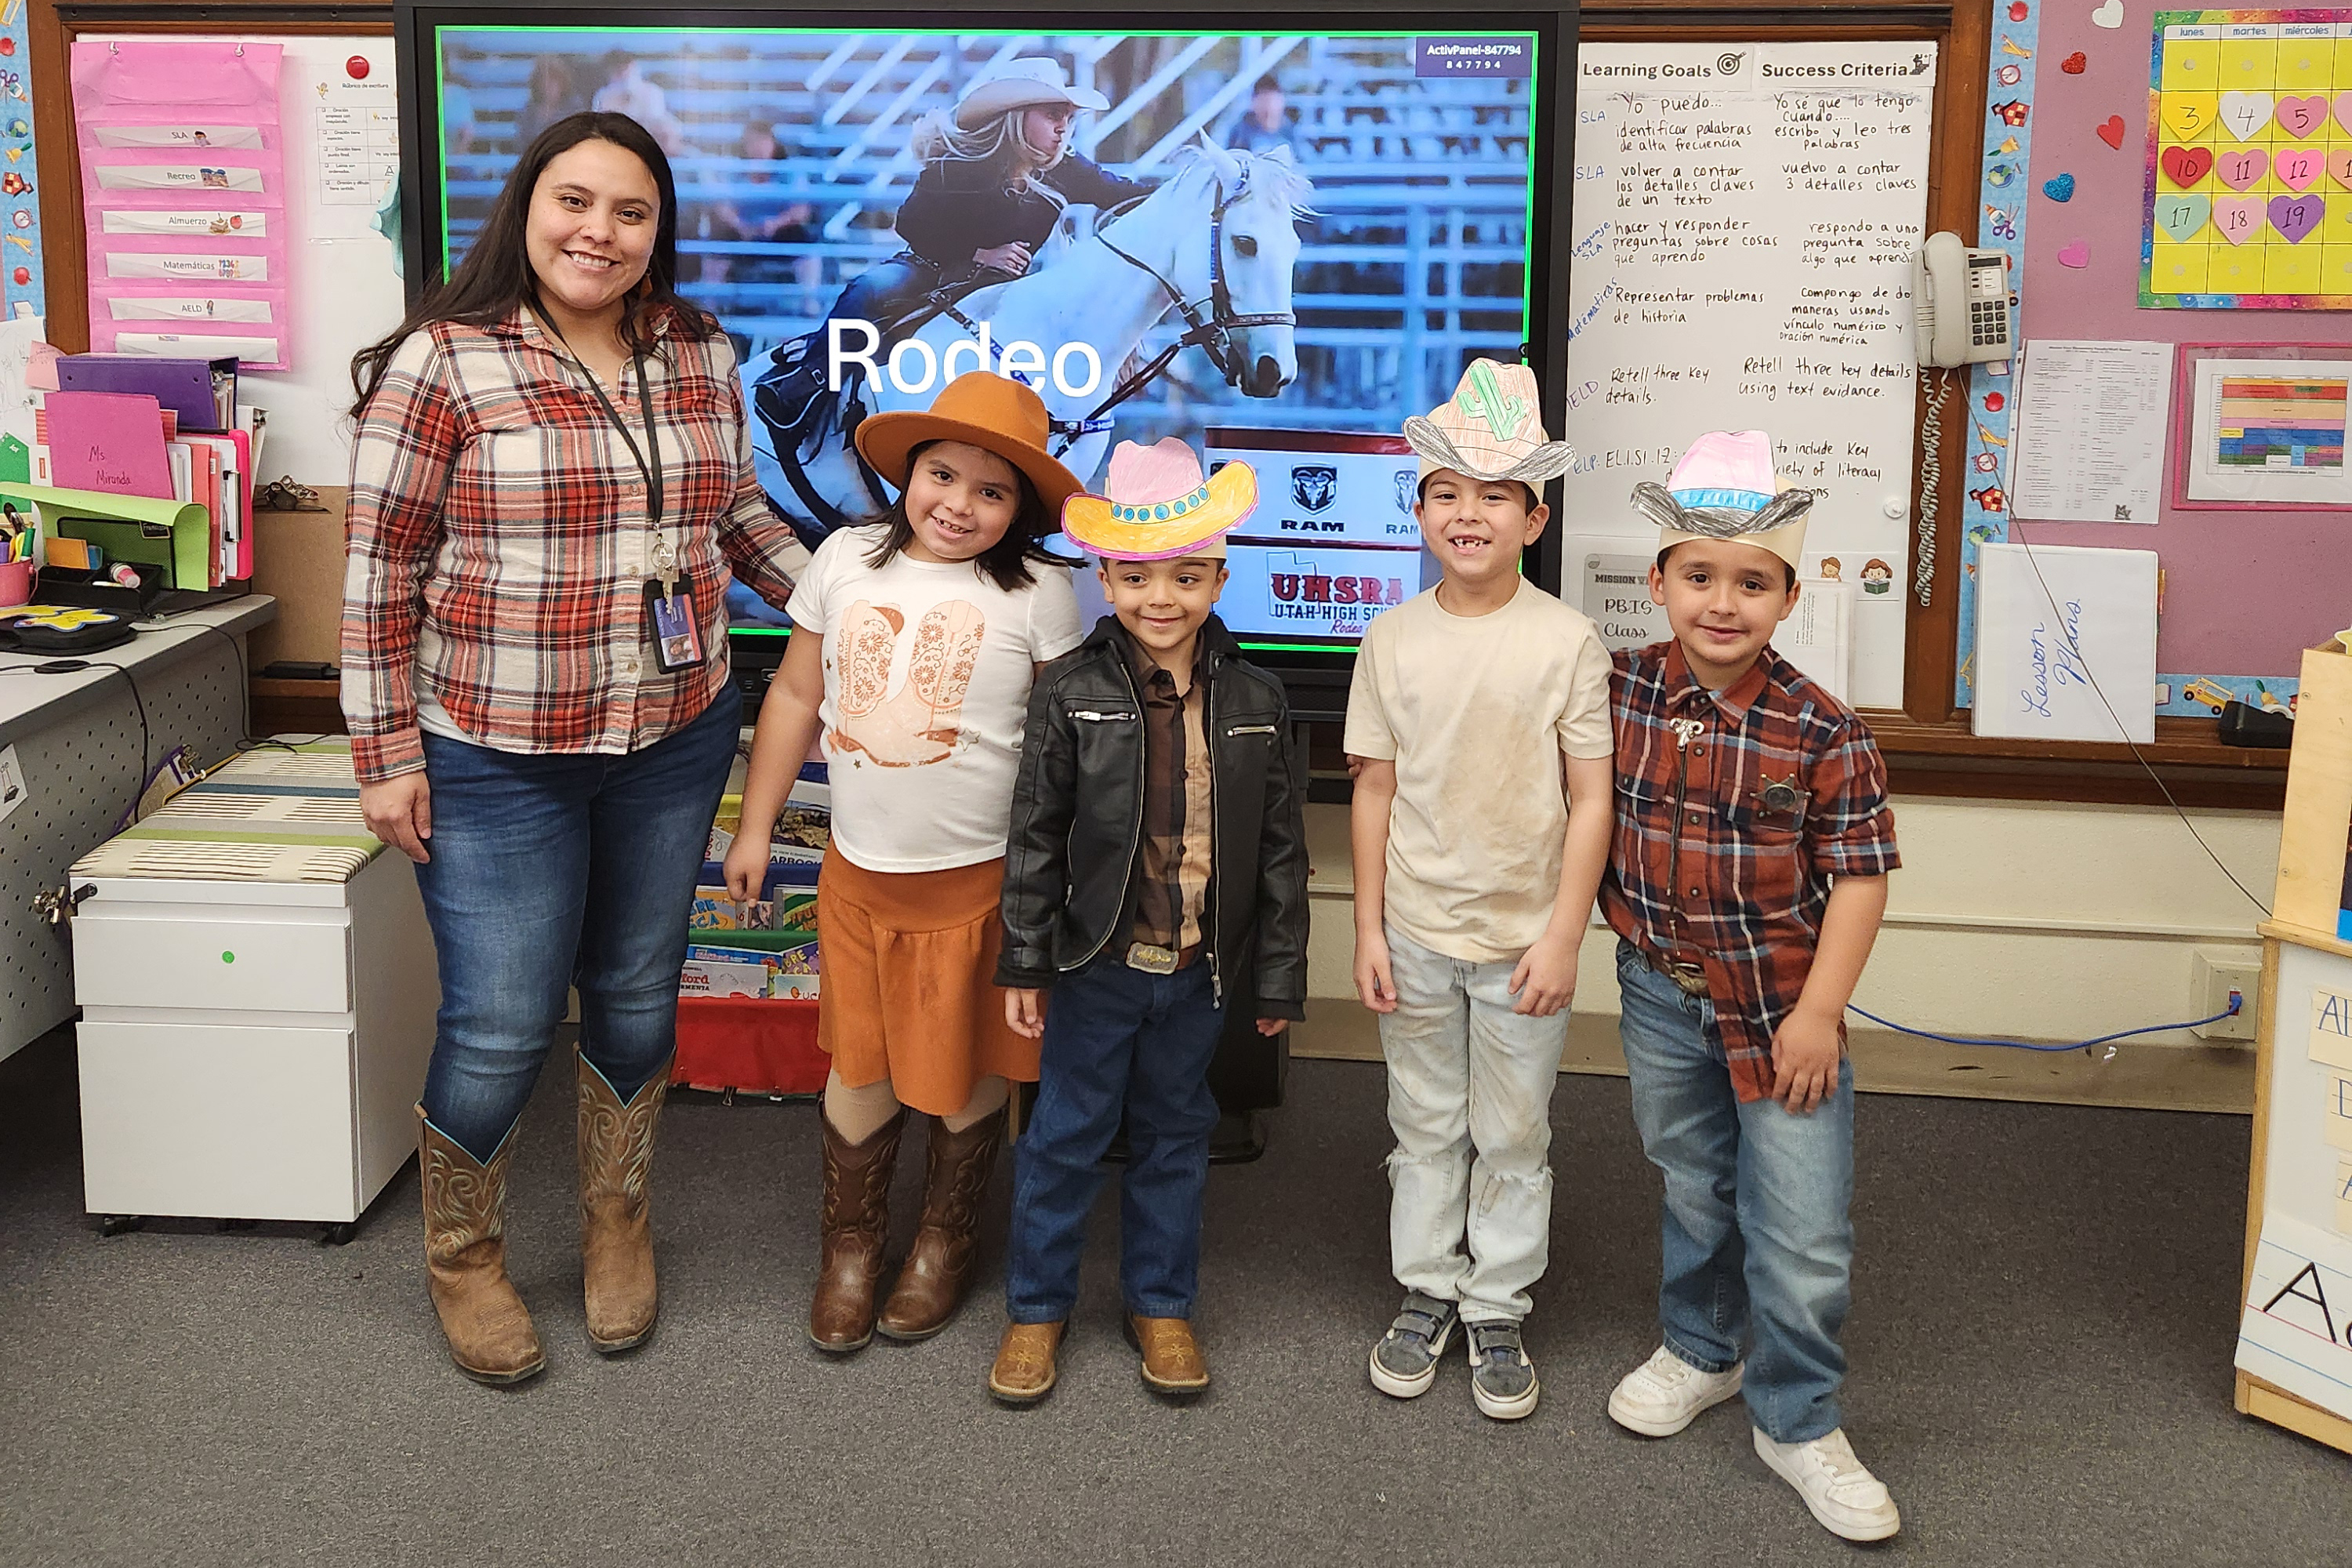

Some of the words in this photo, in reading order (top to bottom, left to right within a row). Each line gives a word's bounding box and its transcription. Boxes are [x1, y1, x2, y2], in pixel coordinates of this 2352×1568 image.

[2233, 27, 2267, 35] martes
[2285, 26, 2329, 34] miércoles
[1427, 44, 1522, 56] ActivPanel-847794
[1584, 64, 1657, 79] Learning
[1662, 64, 1711, 77] Goals
[1762, 64, 1836, 76] Success
[1842, 63, 1907, 76] Criteria
[1621, 92, 1643, 113] Yo
[1773, 93, 1788, 110] Yo
[1795, 96, 1809, 109] sé
[1818, 98, 1841, 113] que
[1854, 94, 1864, 107] lo
[1875, 93, 1914, 112] tengo
[1581, 111, 1606, 123] SLA
[2179, 106, 2200, 130] 3
[2238, 106, 2256, 132] 4
[2295, 108, 2310, 129] 5
[1615, 120, 1688, 137] identificar
[1696, 121, 1752, 139] palabras
[1774, 124, 1820, 136] escribo
[1832, 127, 1841, 139] y
[1855, 122, 1877, 136] leo
[1887, 121, 1911, 134] tres
[1620, 138, 1633, 152] de
[1639, 139, 1667, 151] alta
[1675, 136, 1742, 150] frecuencia
[166, 172, 196, 180] Recreo
[1575, 165, 1605, 180] SLA
[1621, 162, 1663, 177] volver
[1672, 167, 1682, 177] a
[1693, 163, 1744, 177] contar
[1781, 161, 1827, 174] vuelvo
[1837, 165, 1847, 175] a
[1857, 160, 1901, 176] contar
[2177, 159, 2198, 179] 10
[2234, 159, 2251, 181] 11
[2289, 160, 2309, 180] 12
[1617, 180, 1633, 192] los
[1644, 179, 1698, 191] detalles
[1710, 179, 1755, 191] claves
[1786, 176, 1795, 190] 3
[1805, 177, 1864, 191] detalles
[1875, 177, 1918, 191] claves
[1617, 195, 1632, 207] de
[1642, 195, 1659, 206] un
[1673, 195, 1713, 206] texto
[168, 216, 208, 225] Almuerzo
[2169, 207, 2192, 229] 17
[2228, 210, 2248, 230] 18
[2282, 205, 2306, 229] 19
[1614, 220, 1650, 235] hacer
[1659, 220, 1668, 238] y
[1675, 216, 1751, 234] responder
[1809, 219, 1874, 236] respondo
[1881, 223, 1889, 232] a
[1896, 224, 1919, 234] una
[1571, 220, 1611, 258] Lenguaje
[1612, 237, 1683, 252] preguntas
[1695, 235, 1730, 248] sobre
[1742, 235, 1779, 247] cosas
[1802, 236, 1864, 252] pregunta
[1581, 243, 1603, 261] SLA
[1614, 253, 1635, 268] que
[1651, 248, 1706, 267] aprendo
[163, 261, 215, 270] Matemáticas
[1802, 253, 1826, 269] algo
[1834, 254, 1857, 268] que
[1615, 286, 1696, 305] Representar
[1705, 286, 1764, 307] problemas
[1872, 285, 1889, 298] de
[1895, 285, 1913, 299] do
[181, 304, 203, 313] AELD
[1613, 308, 1630, 324] de
[1641, 309, 1687, 324] historia
[1791, 305, 1839, 317] maneras
[1849, 303, 1891, 315] usando
[1783, 318, 1825, 331] vínculo
[1833, 320, 1887, 332] numérico
[1895, 323, 1904, 334] y
[1820, 334, 1868, 345] numérica
[828, 318, 1102, 397] Rodeo
[1653, 364, 1680, 381] three
[1743, 356, 1783, 376] Retell
[1795, 356, 1833, 376] three
[1870, 362, 1912, 379] details
[1786, 381, 1815, 397] text
[89, 445, 106, 462] Ms
[1776, 439, 1788, 453] to
[1795, 440, 1834, 456] include
[96, 469, 132, 485] Miranda
[1813, 461, 1826, 477] of
[1280, 519, 1345, 532] RAM
[1595, 574, 1636, 584] MISSION
[1270, 573, 1404, 606] UHSRA
[1275, 604, 1316, 620] UTAH
[1322, 606, 1358, 621] HIGH
[1605, 598, 1653, 615] PBIS
[1330, 619, 1363, 634] Rodeo
[1603, 622, 1650, 638] Class
[2053, 599, 2087, 686] Plans
[2021, 622, 2052, 717] Lesson
